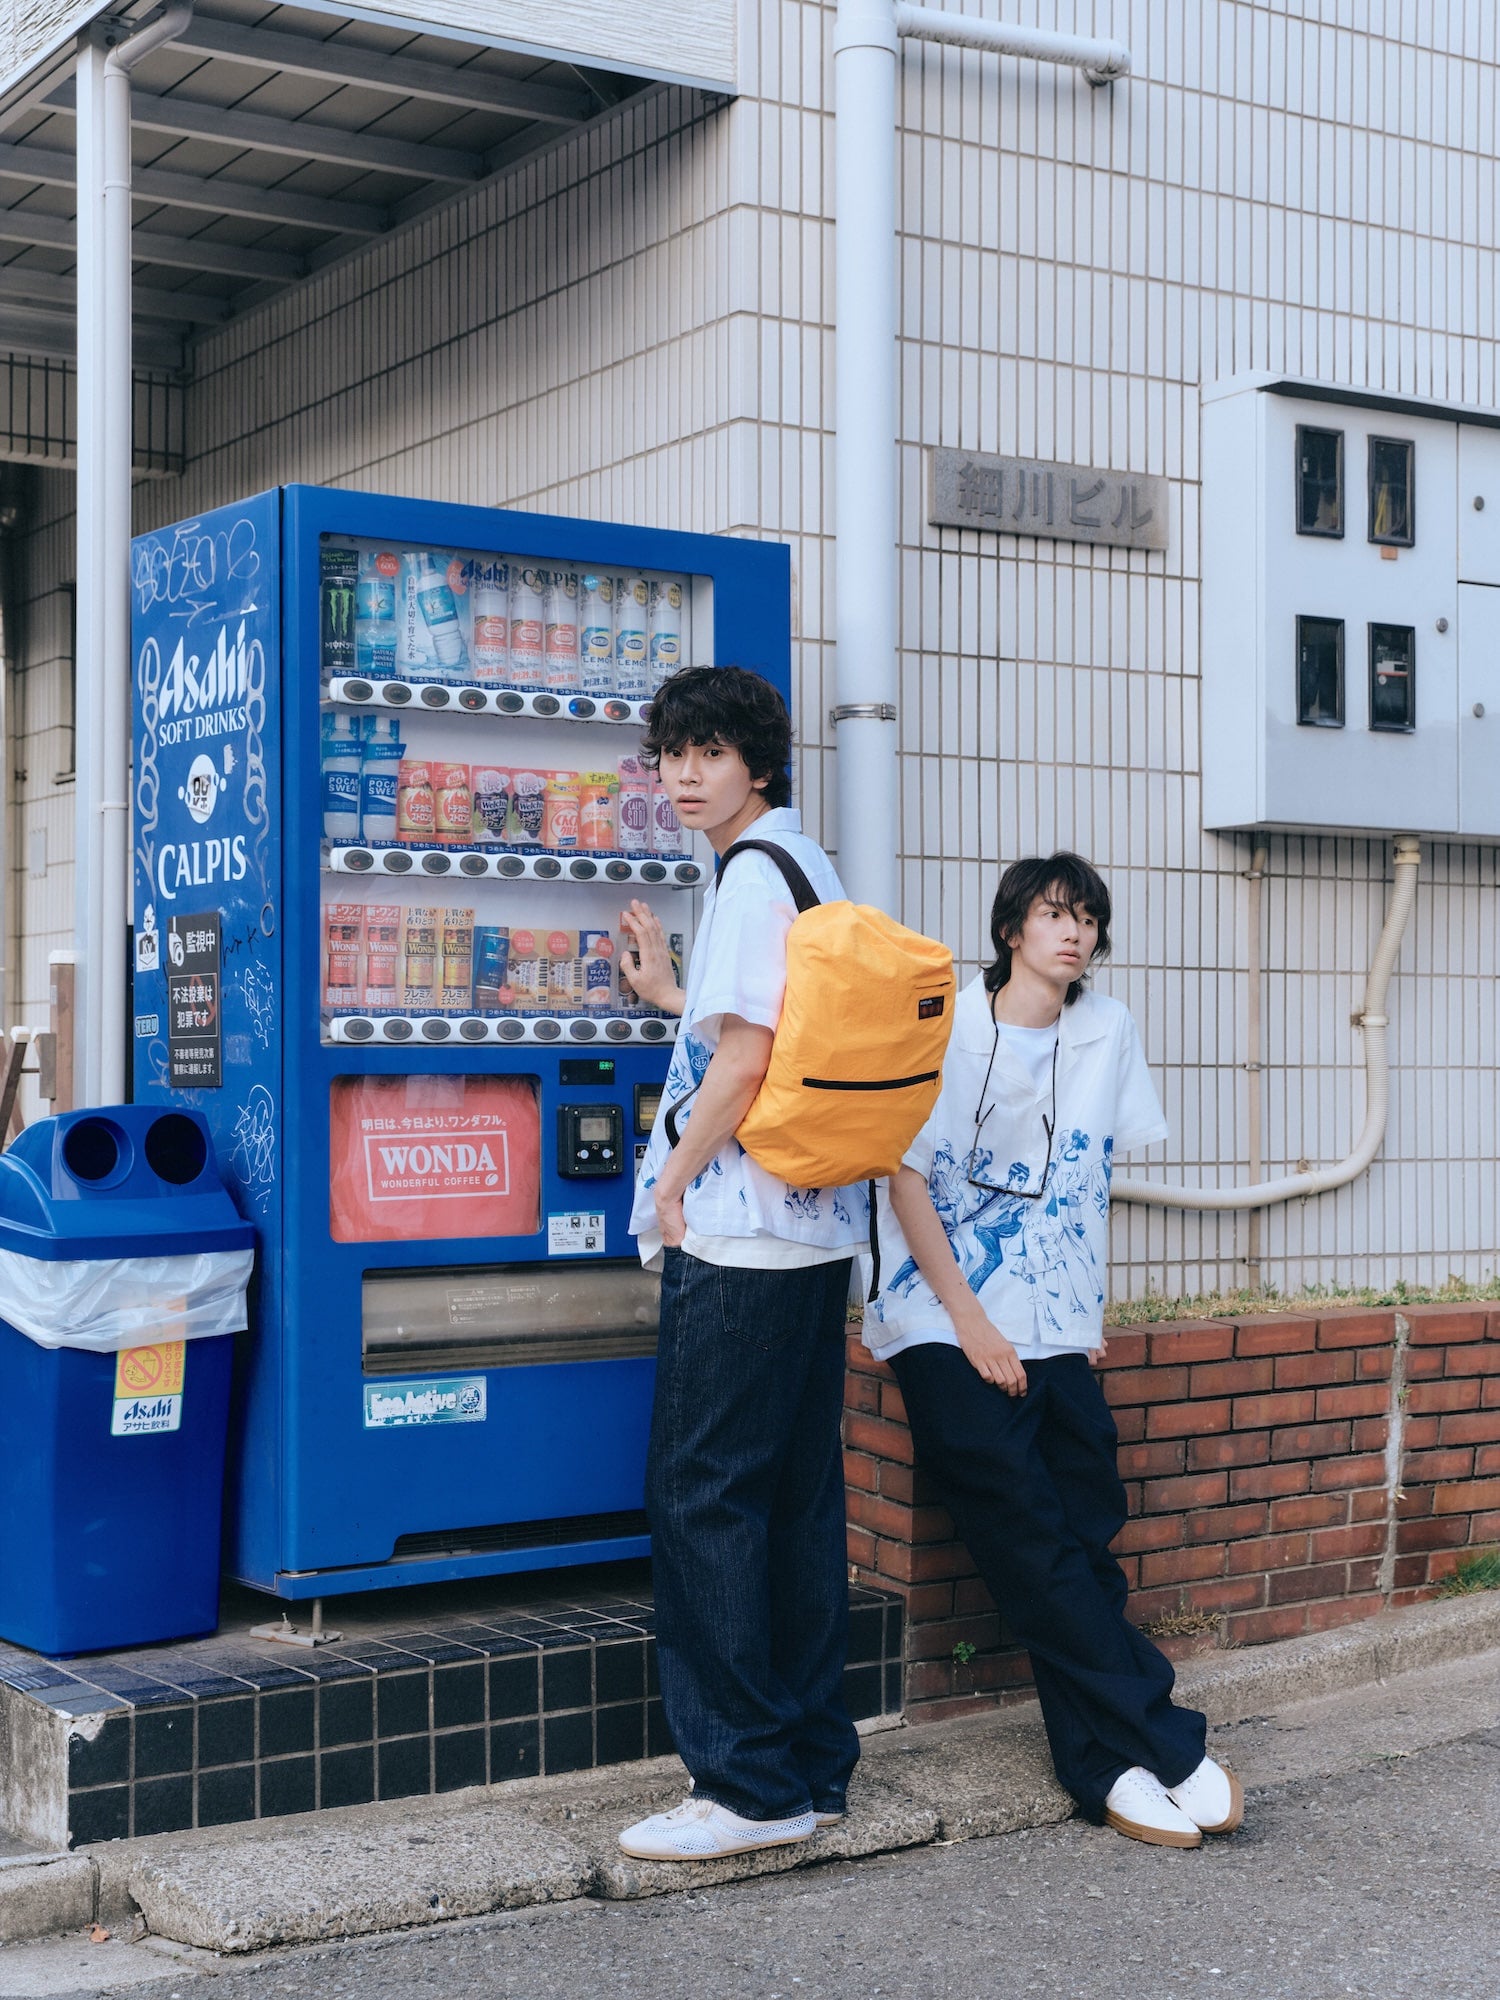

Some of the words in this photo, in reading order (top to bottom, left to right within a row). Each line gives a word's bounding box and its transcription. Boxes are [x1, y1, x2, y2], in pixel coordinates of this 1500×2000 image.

[522, 569, 578, 587] CALPIS
[158, 619, 246, 719] Asahi
[159, 718, 193, 747] SOFT
[195, 706, 246, 739] DRINKS
[158, 835, 247, 900] CALPIS
[186, 929, 215, 953] 監視中
[331, 941, 360, 952] WONDA
[369, 942, 398, 953] WONDA
[173, 985, 213, 1004] 不法投棄は
[136, 1017, 159, 1035] TERU
[177, 1009, 209, 1028] 犯罪です
[361, 1114, 507, 1131] 明日は、今日より、ワンダフル。
[378, 1143, 498, 1175] WONDA
[380, 1177, 440, 1188] WONDERFUL
[444, 1175, 480, 1187] COFFEE
[124, 1398, 172, 1420] Asahi
[123, 1420, 170, 1432] アサヒ飲料
